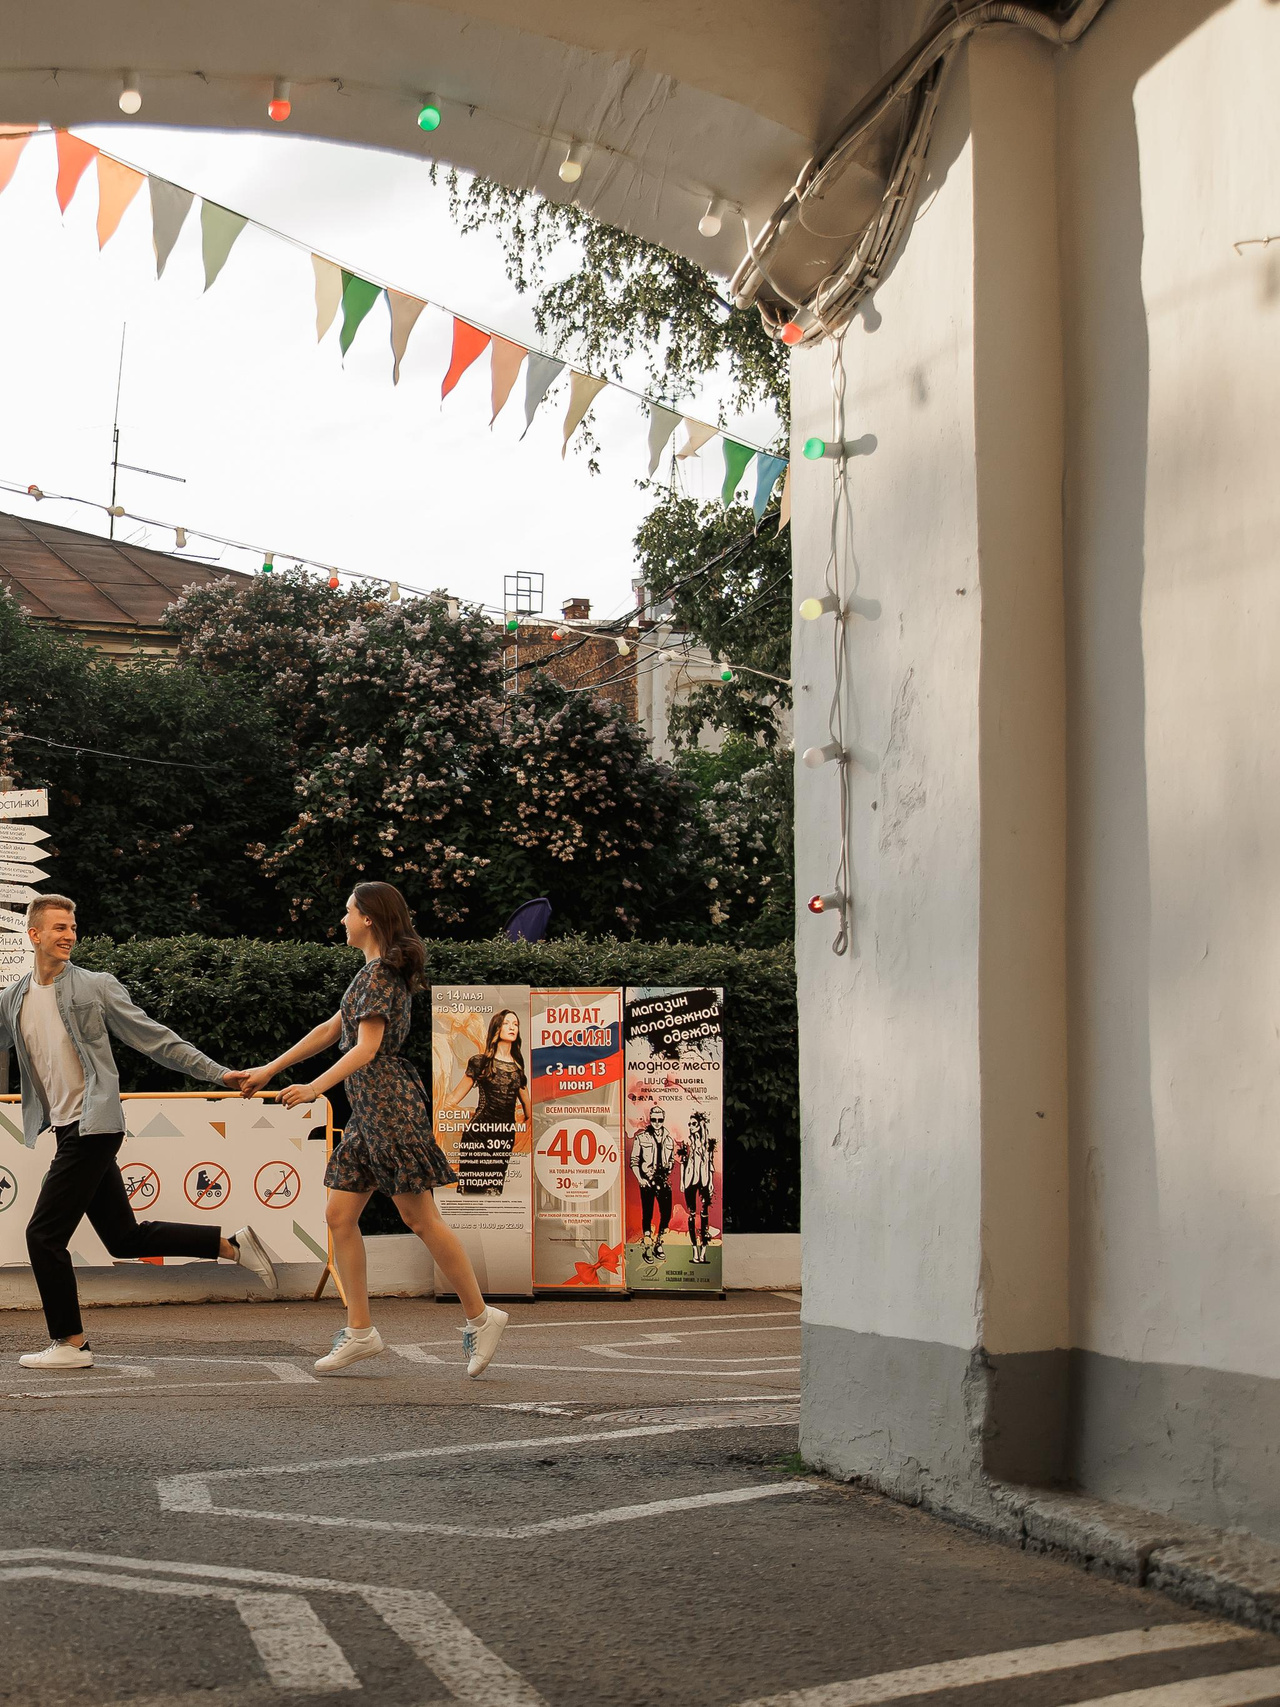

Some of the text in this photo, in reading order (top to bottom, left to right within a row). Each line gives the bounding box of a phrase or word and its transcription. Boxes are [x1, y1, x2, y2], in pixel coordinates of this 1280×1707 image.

[446, 990, 460, 1000] 14
[462, 992, 483, 1000] МАЯ
[451, 1002, 465, 1013] 30
[631, 996, 689, 1018] магазин
[546, 1008, 605, 1026] ВИВАТ,
[630, 1005, 720, 1037] молодежной
[541, 1029, 612, 1046] РОССИЯ!
[663, 1022, 721, 1044] одежды
[556, 1062, 564, 1076] 3
[568, 1065, 586, 1076] по
[590, 1062, 606, 1076] 13
[627, 1061, 720, 1074] модное место
[559, 1081, 593, 1090] июня
[438, 1110, 470, 1119] ВСЕМ
[546, 1106, 610, 1114] ВСЕМ ПОКУПАТЕЛЯМ
[438, 1123, 527, 1132] ВЫПУСКНИКАМ
[452, 1141, 485, 1150] СКИДКА
[537, 1128, 617, 1166] -40%
